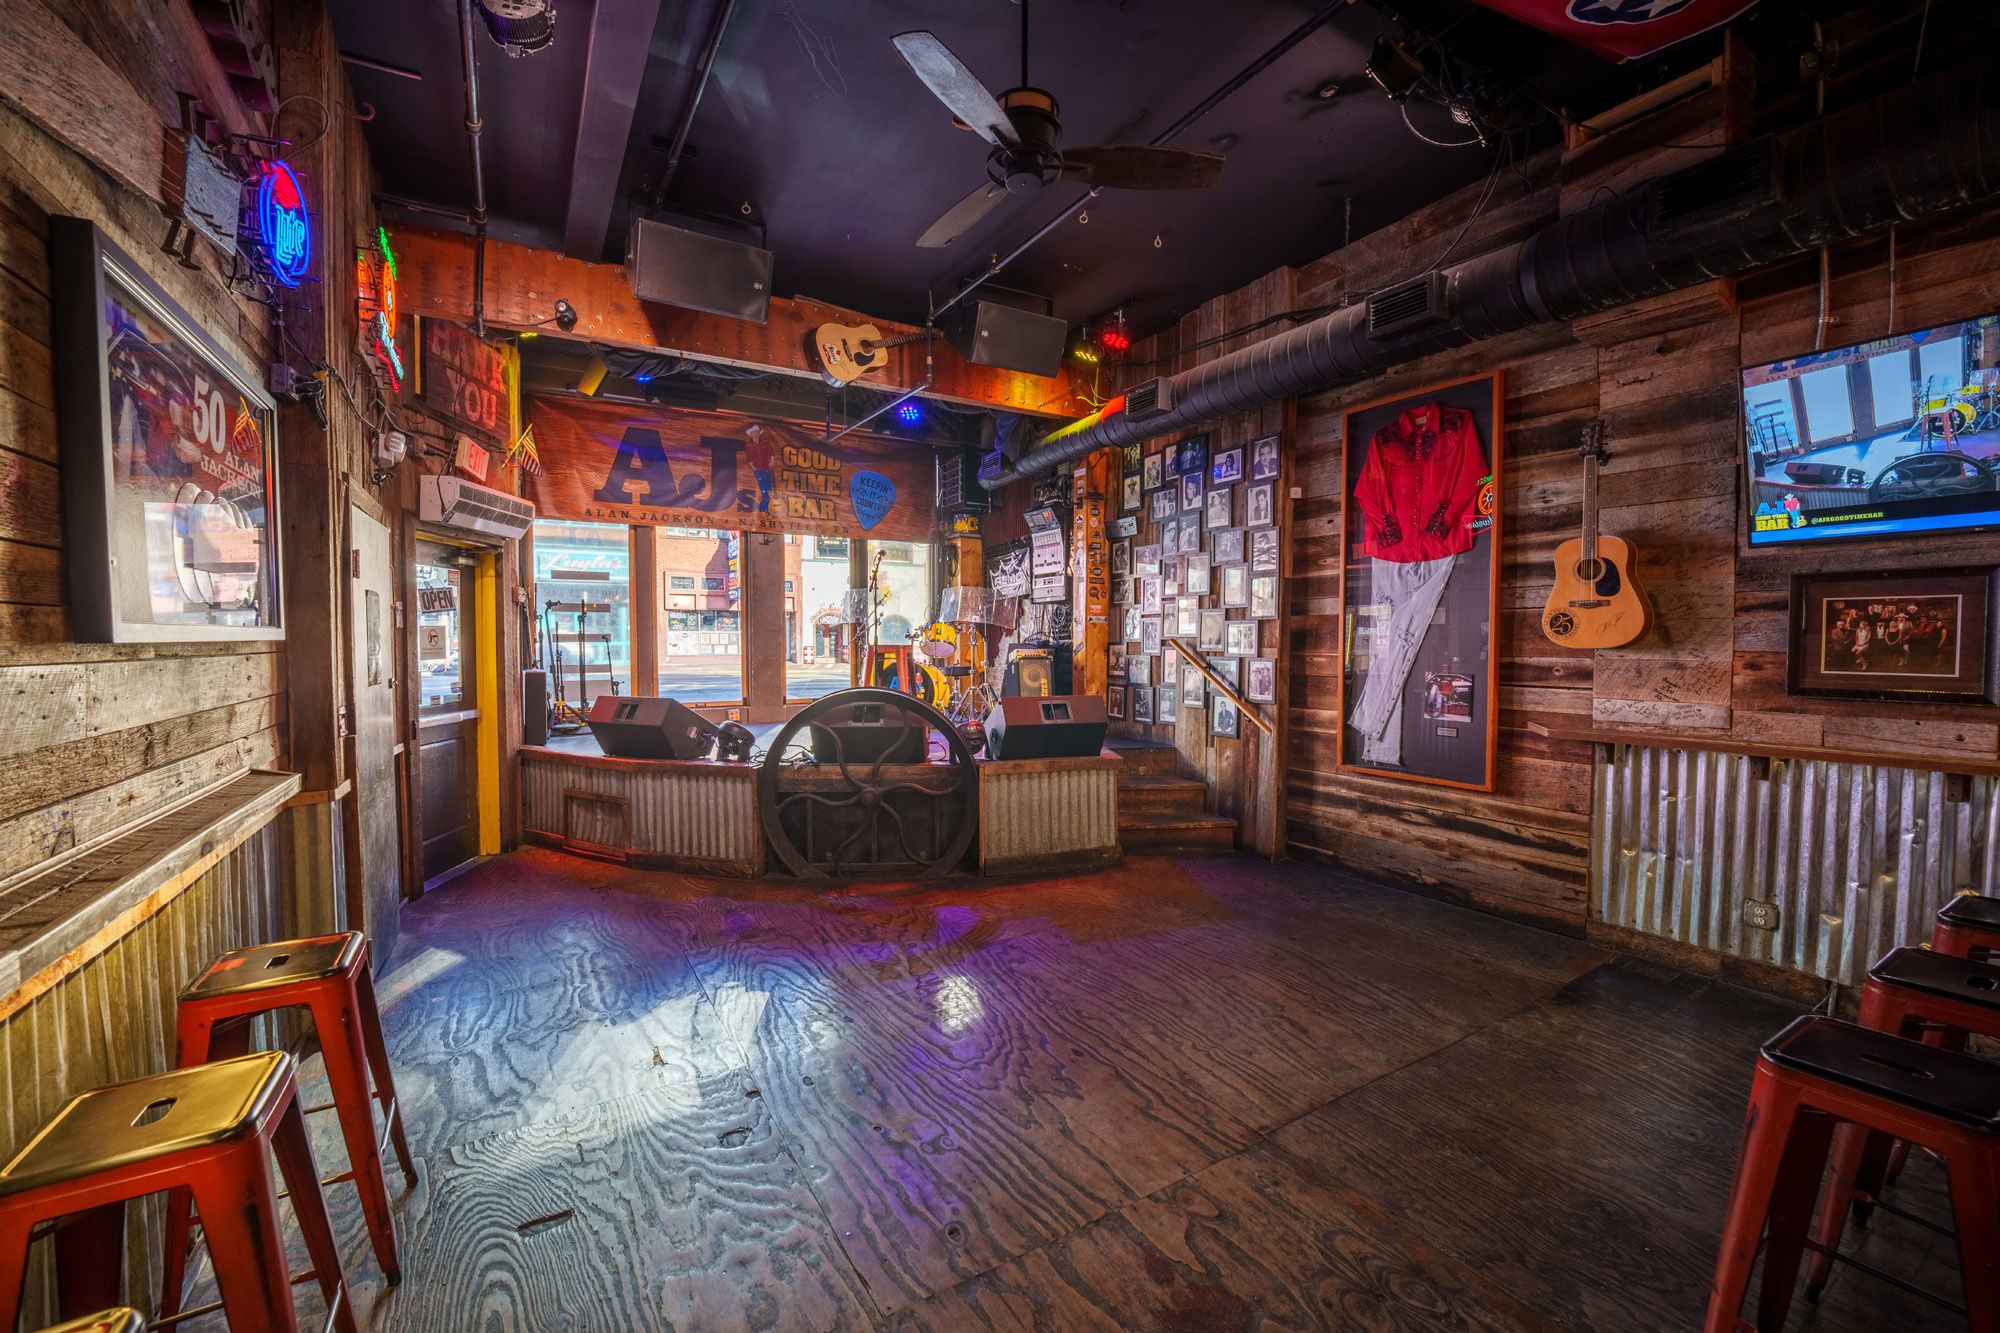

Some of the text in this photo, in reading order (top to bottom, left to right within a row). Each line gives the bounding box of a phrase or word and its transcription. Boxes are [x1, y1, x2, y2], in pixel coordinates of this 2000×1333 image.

[446, 367, 497, 430] YOU
[192, 374, 227, 454] 50
[468, 442, 487, 476] EXIT
[782, 445, 842, 471] GOOD
[781, 469, 842, 496] TIME
[786, 495, 837, 521] BAR
[856, 496, 887, 511] COUNTRY
[583, 508, 630, 519] ALAN
[640, 512, 715, 525] JACKSON
[834, 526, 850, 534] TN
[1756, 518, 1790, 531] BAR
[421, 589, 453, 611] OPEN
[1551, 613, 1572, 635] 25
